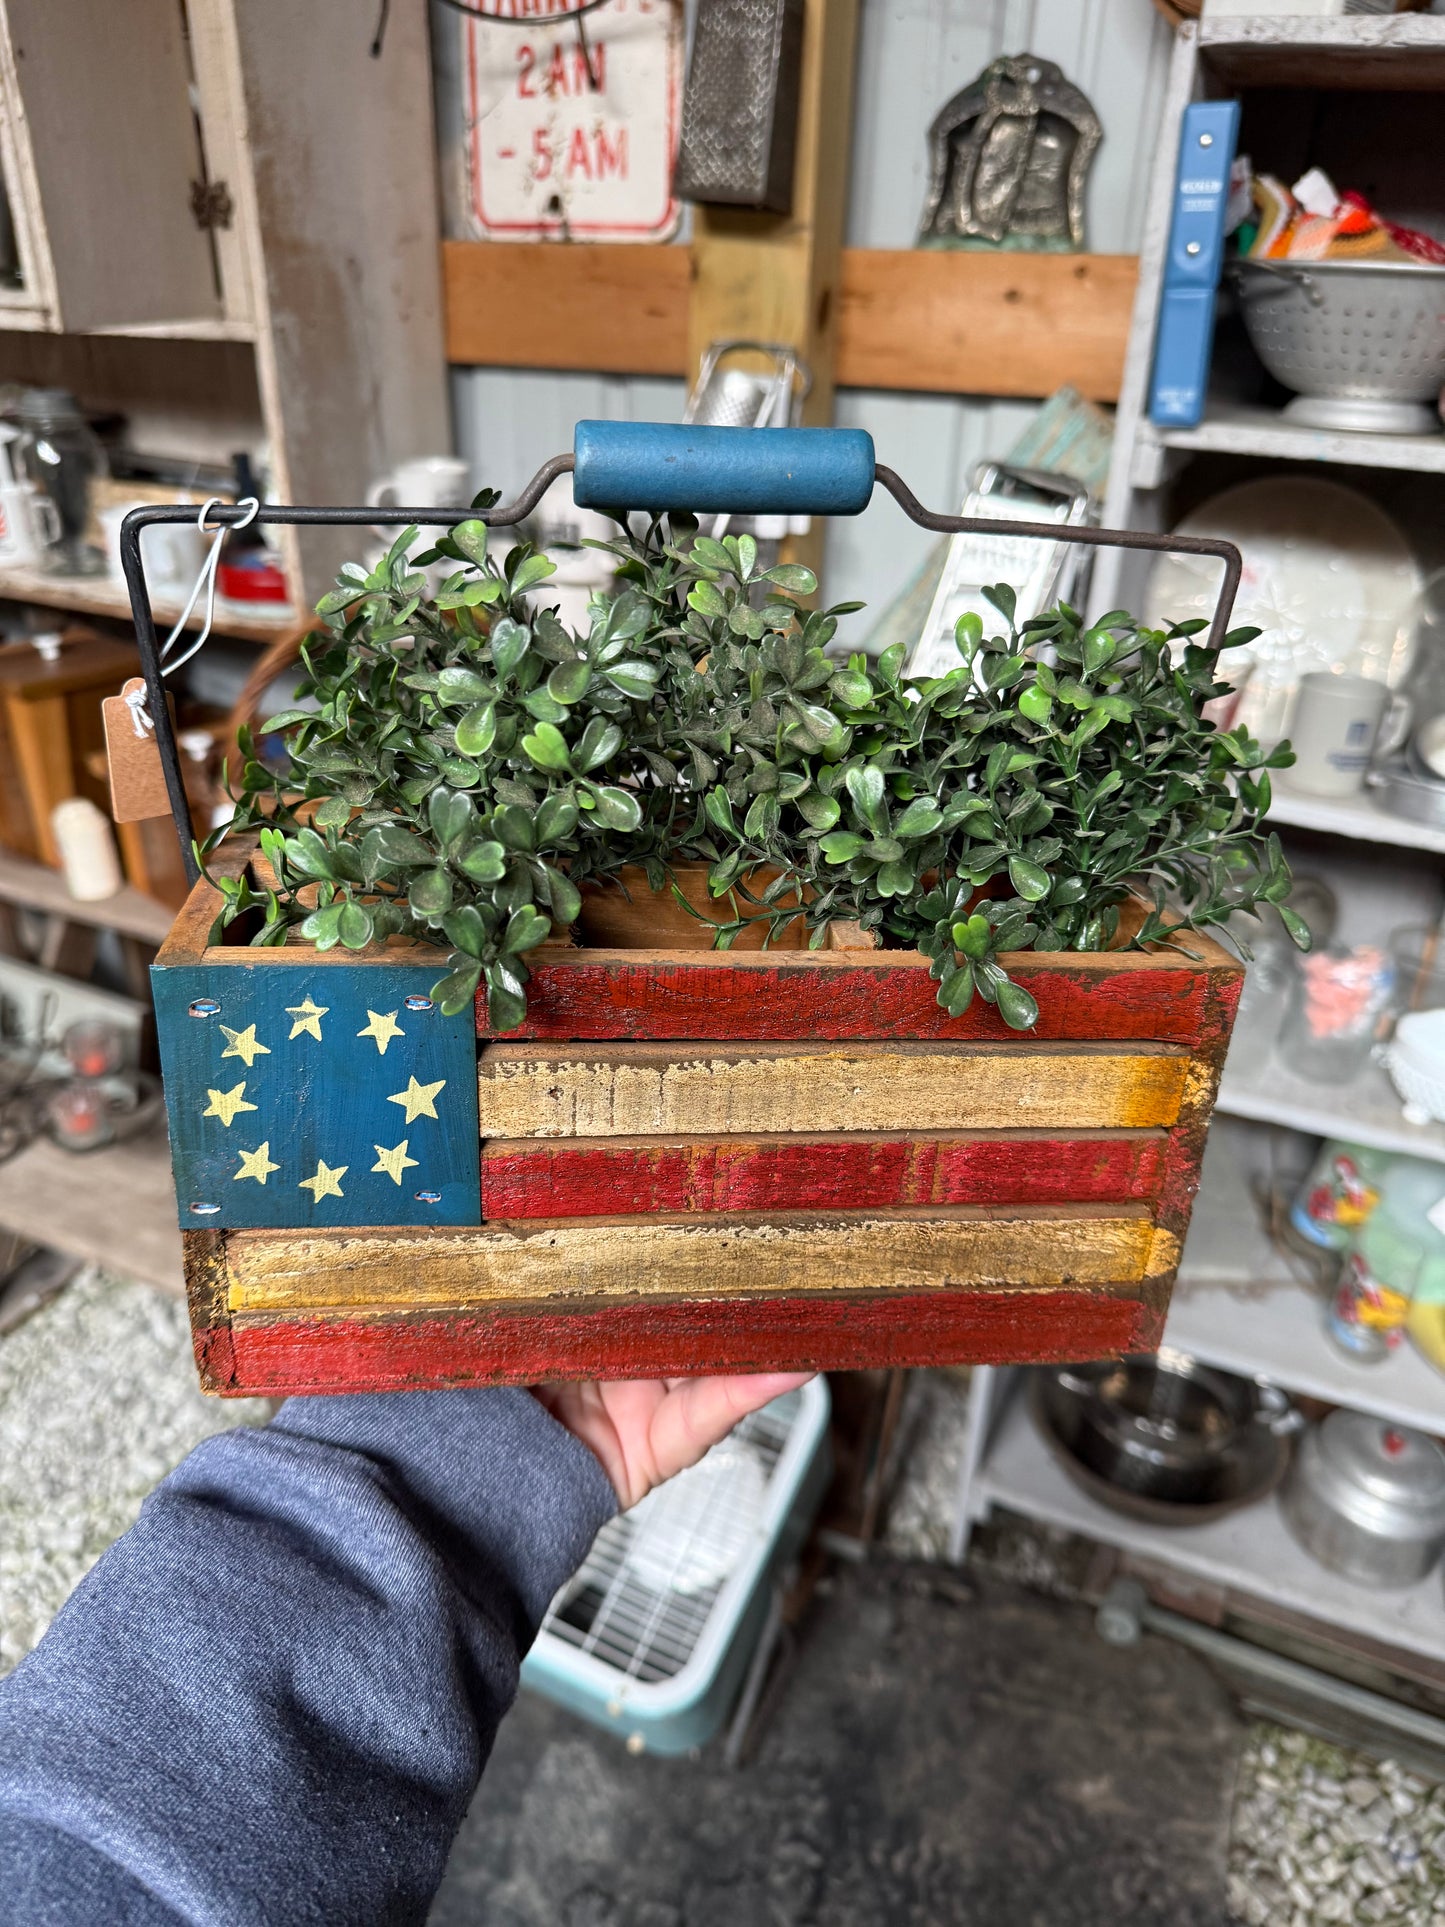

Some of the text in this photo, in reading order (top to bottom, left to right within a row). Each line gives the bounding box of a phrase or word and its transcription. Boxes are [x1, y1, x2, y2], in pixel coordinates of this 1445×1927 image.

[516, 45, 535, 98] 2
[533, 128, 553, 181] 5
[565, 127, 628, 180] AM
